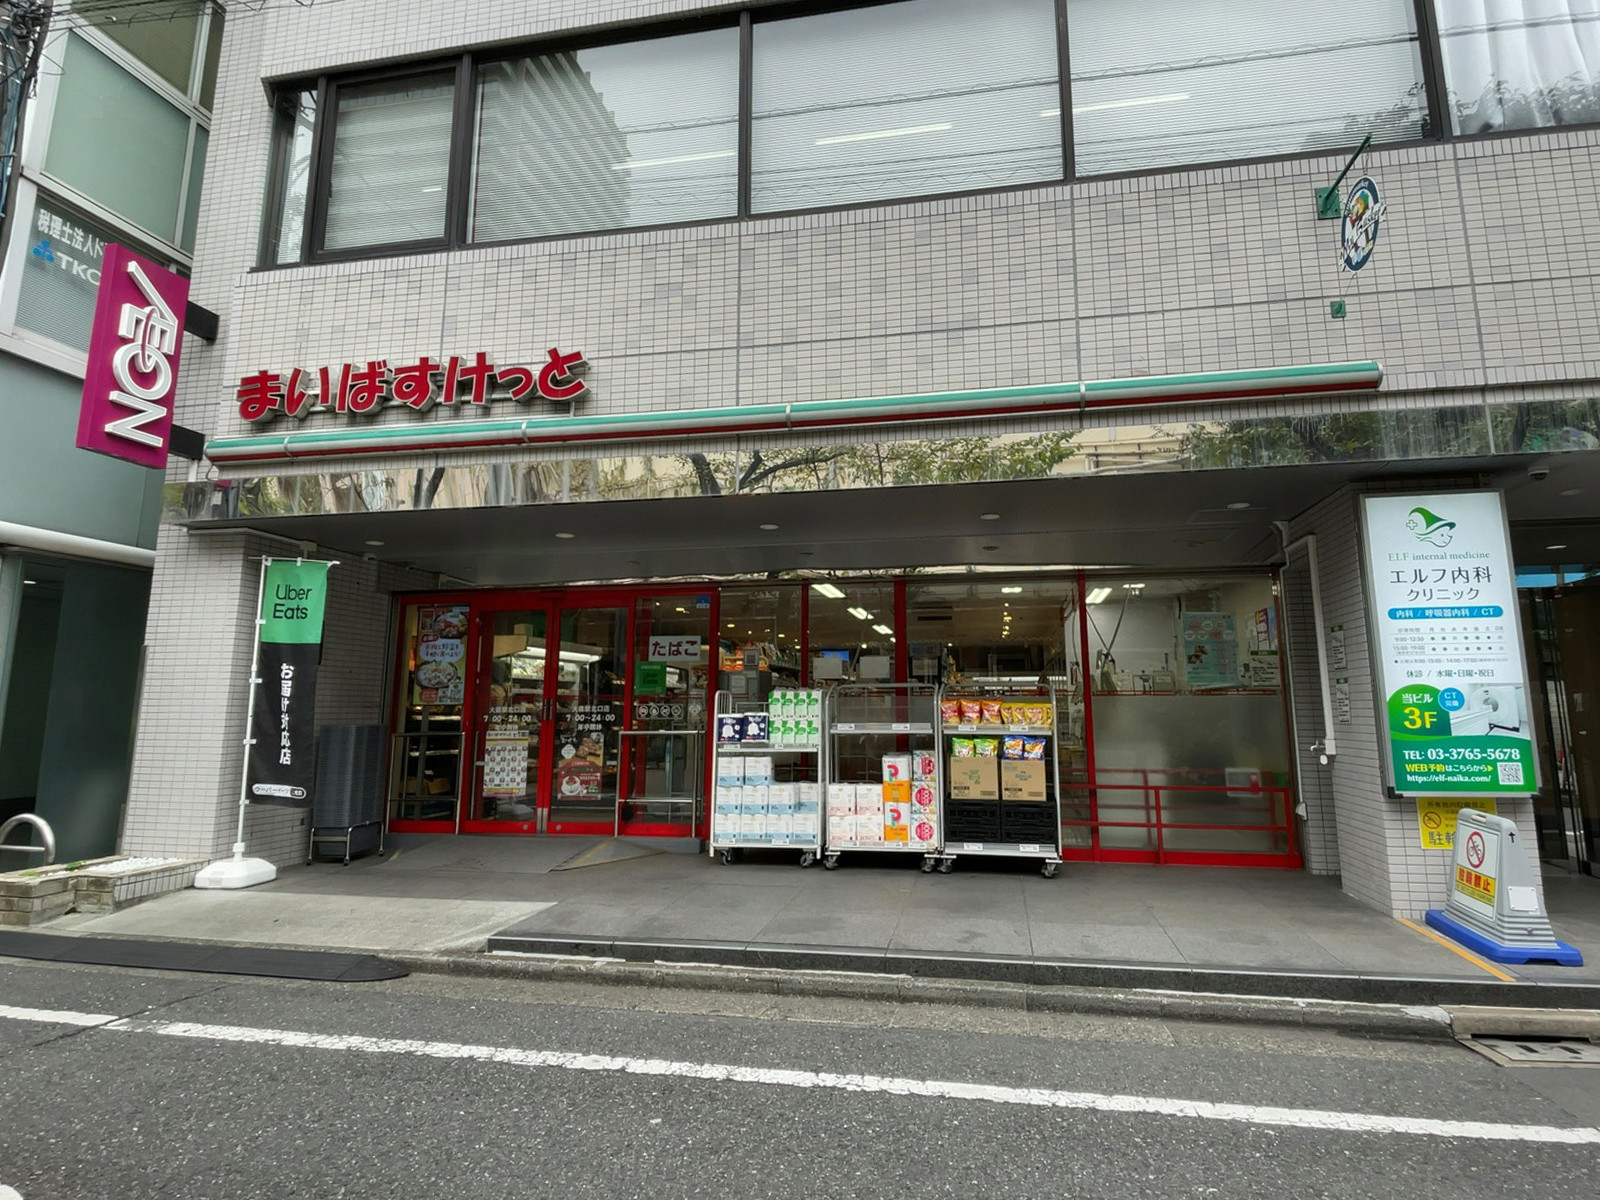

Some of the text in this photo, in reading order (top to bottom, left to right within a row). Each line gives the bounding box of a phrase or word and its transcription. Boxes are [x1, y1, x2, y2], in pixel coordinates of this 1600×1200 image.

[236, 347, 590, 423] まいばすけっと
[1388, 551, 1490, 562] ELF internal medicine
[1390, 565, 1493, 585] エルフ内科
[275, 584, 313, 601] Uber
[1406, 587, 1480, 602] クリニック
[272, 604, 309, 620] Eats
[1396, 609, 1414, 618] 内科
[1481, 607, 1495, 616] CT
[651, 640, 698, 657] たばこ
[1406, 670, 1423, 678] 休診
[1401, 693, 1434, 704] 当ビル
[1444, 692, 1457, 700] CT
[279, 662, 295, 766] お届け対応店
[1403, 707, 1438, 729] 3F
[1403, 748, 1520, 760] TEL: 03-3765-5678
[1406, 775, 1491, 784] https://elf-naika.com/
